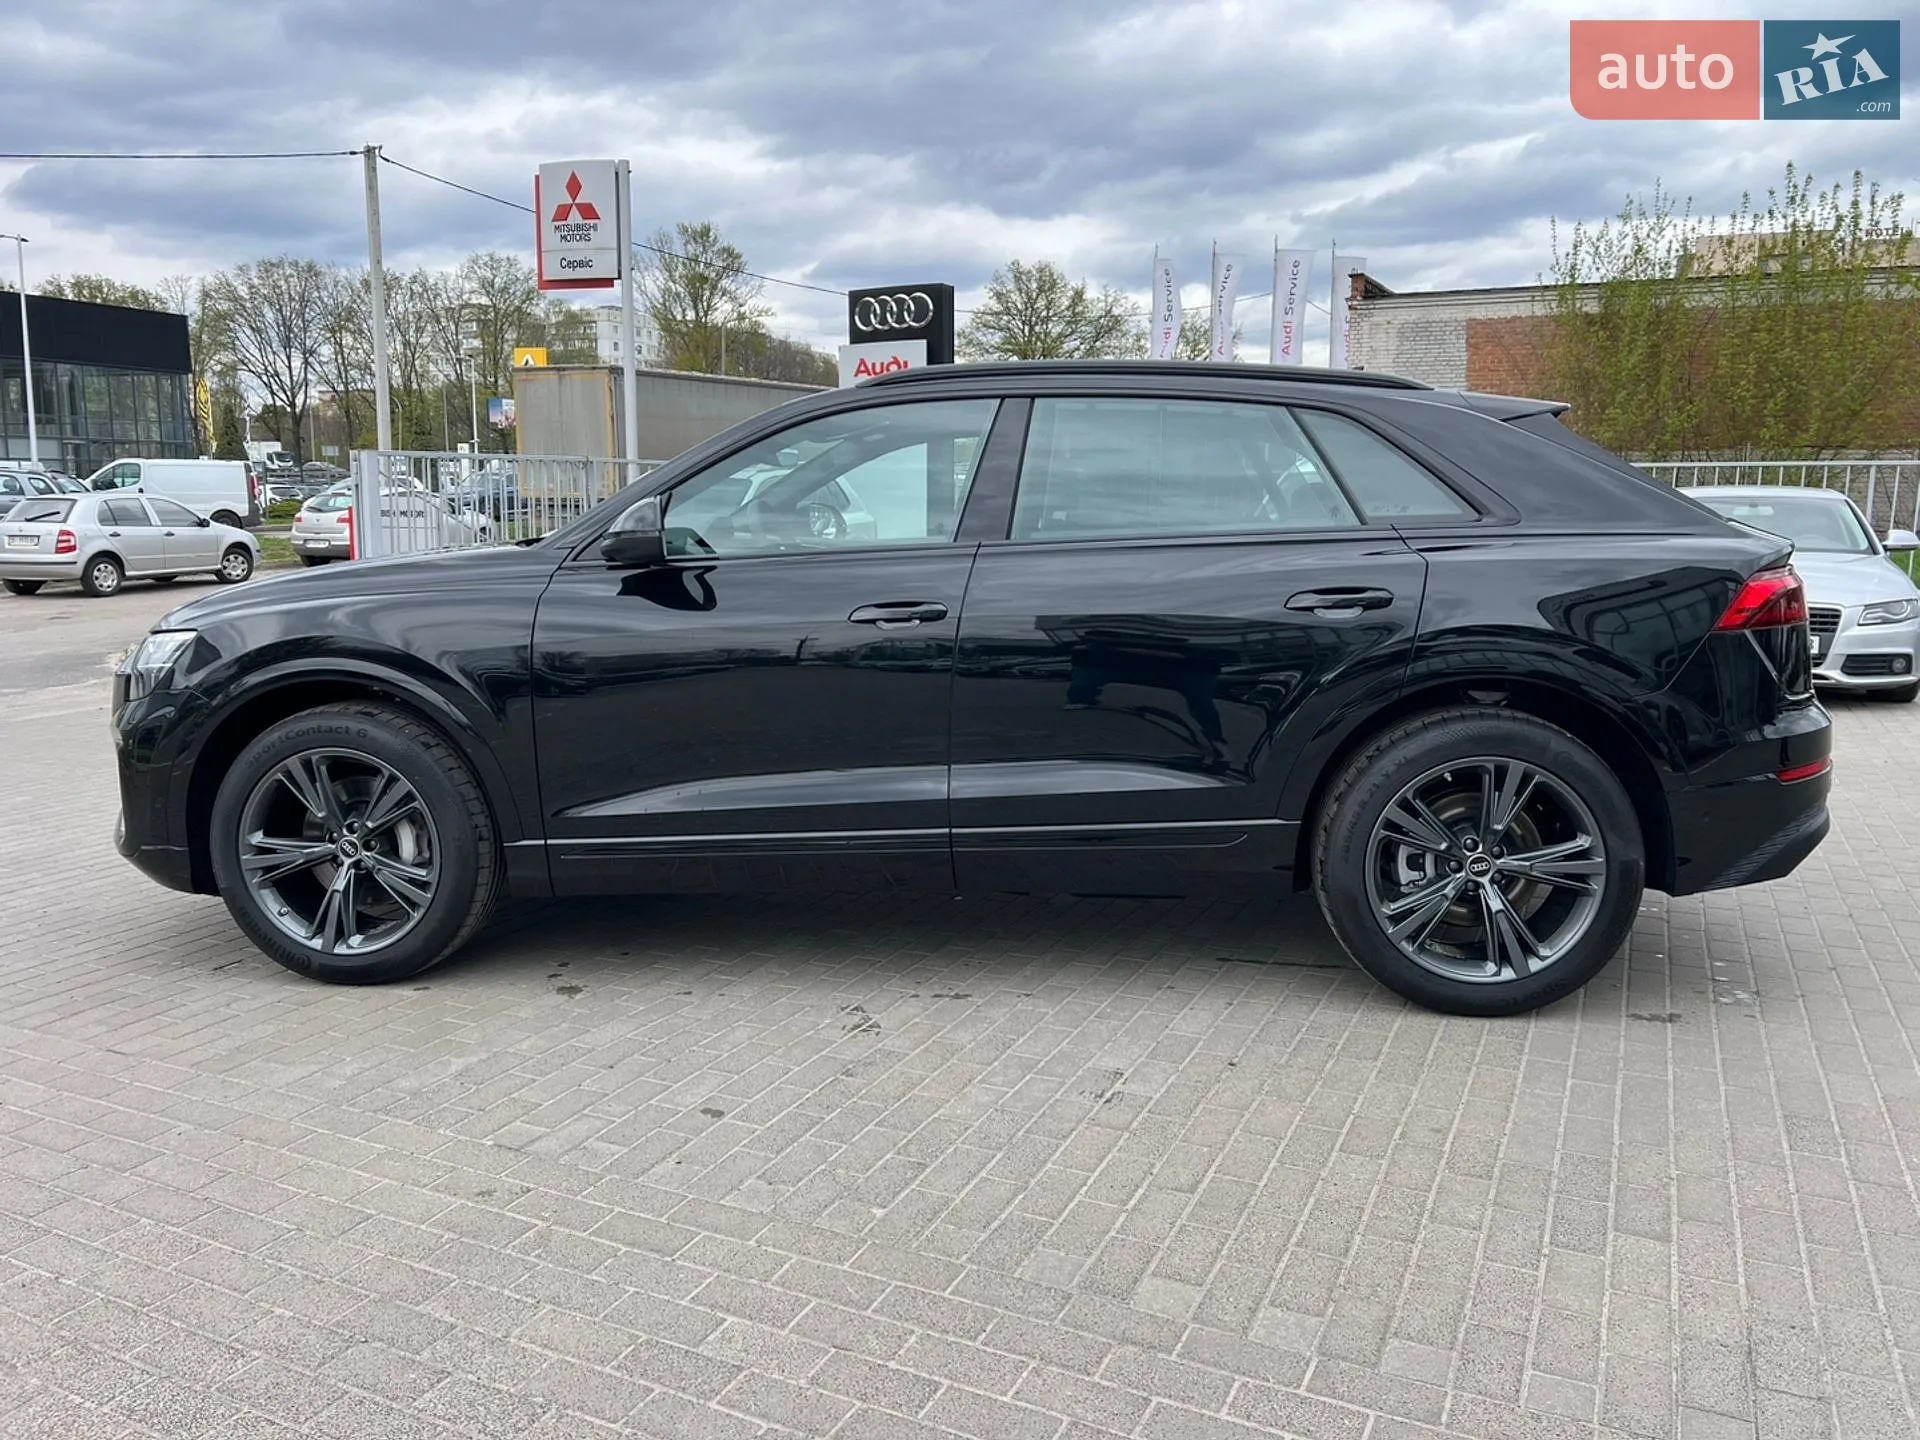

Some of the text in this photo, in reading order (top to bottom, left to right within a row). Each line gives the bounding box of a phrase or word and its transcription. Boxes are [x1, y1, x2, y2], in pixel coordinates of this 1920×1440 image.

[554, 223, 598, 233] MITSUBISHI
[560, 233, 591, 242] MOTORS
[560, 256, 593, 271] Сервіс
[1163, 268, 1174, 323] Service
[1218, 263, 1234, 315] ervice
[1281, 259, 1300, 356] Audi Service
[356, 727, 369, 738] 6
